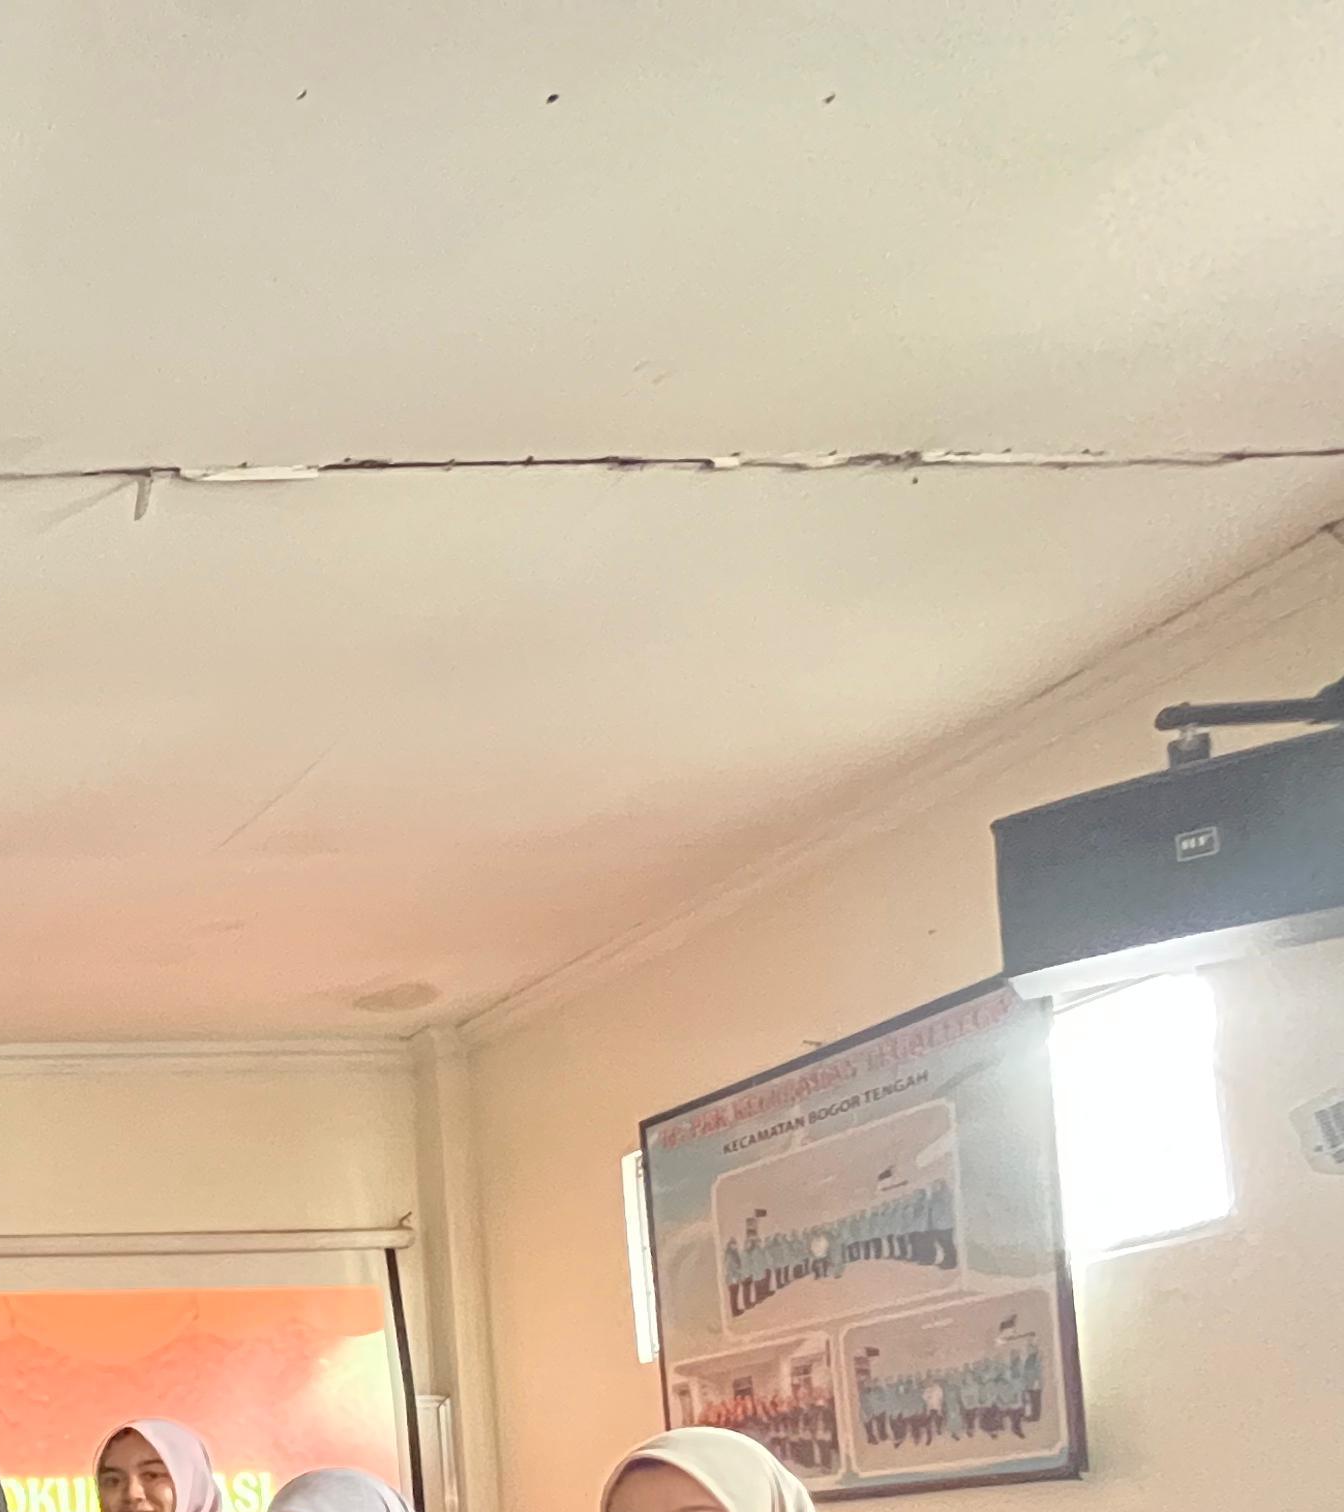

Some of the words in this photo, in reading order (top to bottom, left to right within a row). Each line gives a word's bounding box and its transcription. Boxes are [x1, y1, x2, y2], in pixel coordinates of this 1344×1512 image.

[722, 1115, 806, 1155] KECAMATAN
[808, 1094, 861, 1125] BOGOR
[863, 1068, 929, 1103] TENGAH
